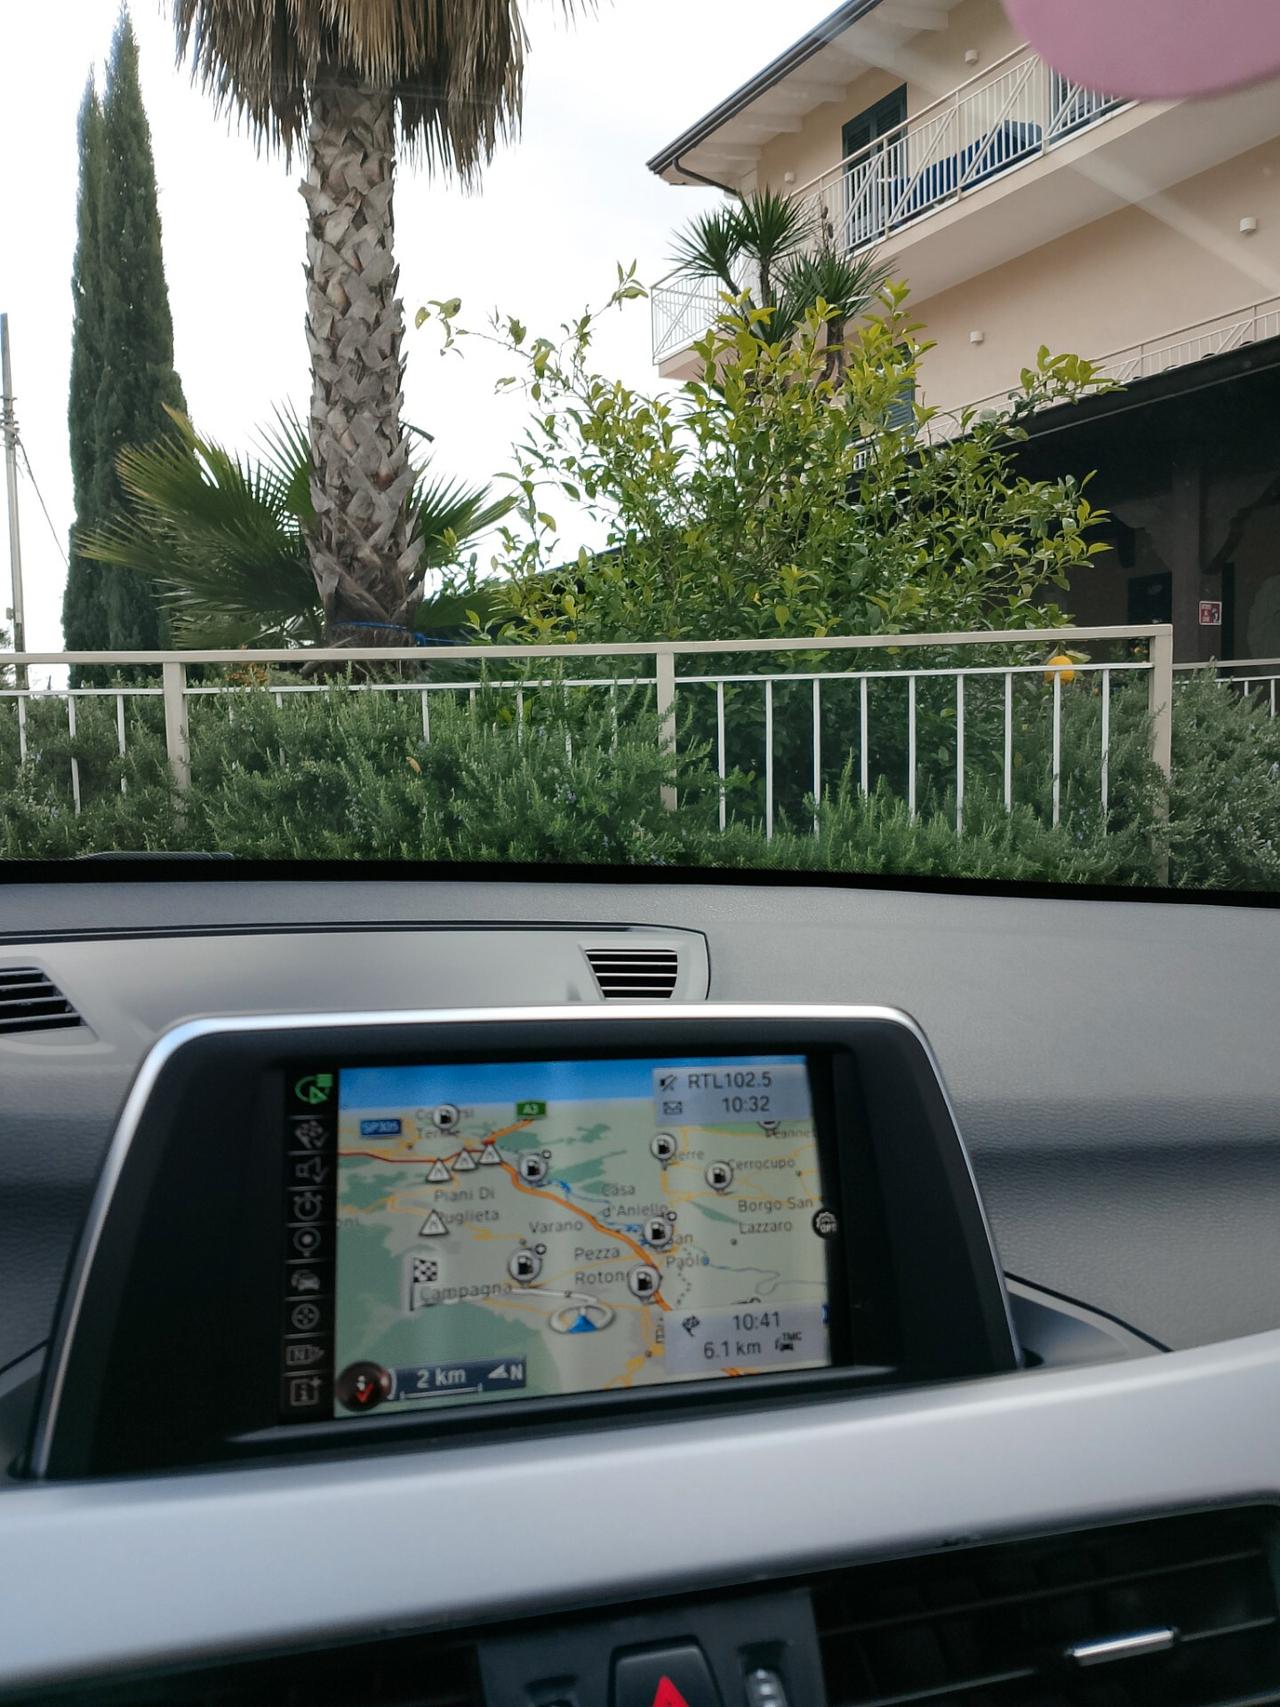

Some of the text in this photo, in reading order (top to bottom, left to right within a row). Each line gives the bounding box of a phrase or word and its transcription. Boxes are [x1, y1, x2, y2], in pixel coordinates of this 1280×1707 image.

[687, 1071, 773, 1089] RTL102.5
[722, 1095, 770, 1112] 10:32
[479, 1186, 495, 1200] Di
[738, 1196, 814, 1215] Borgo San
[529, 1220, 584, 1235] Varano
[739, 1220, 793, 1235] Lazzaro
[574, 1245, 621, 1261] Pezza
[732, 1311, 780, 1331] 10:41
[703, 1340, 762, 1360] 6.1 km
[416, 1367, 467, 1389] 2 km
[510, 1364, 523, 1381] N
